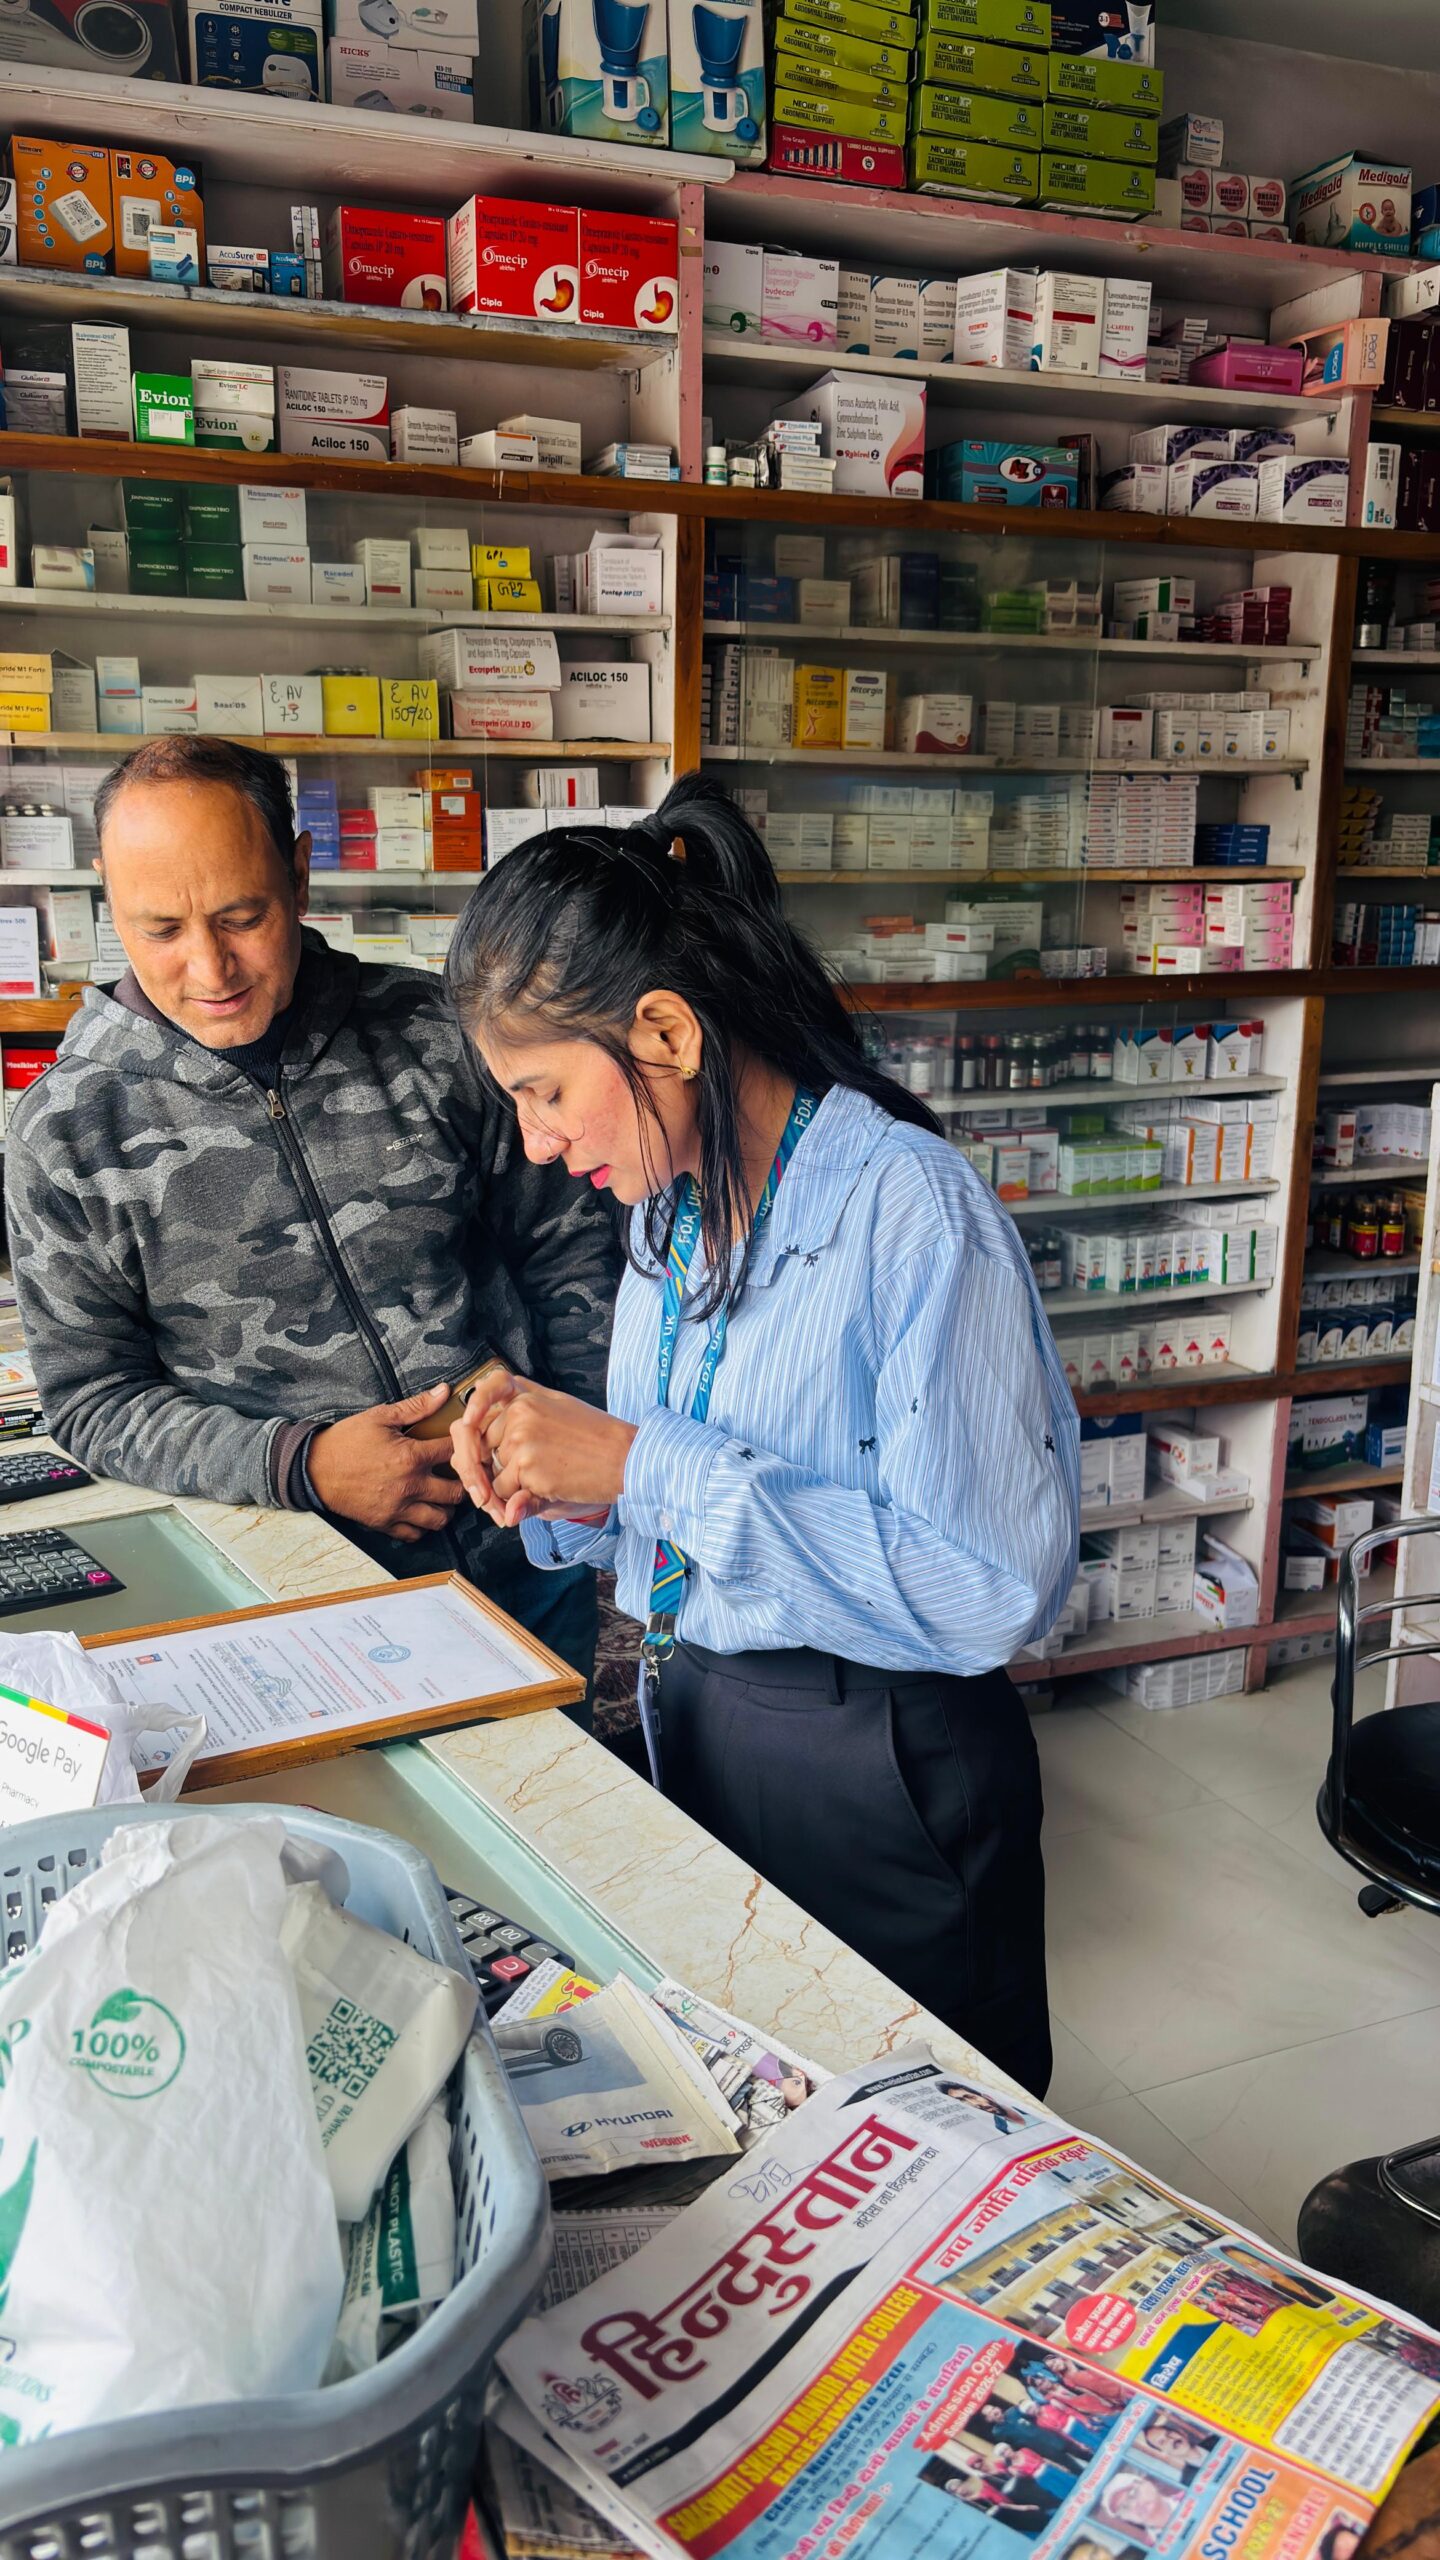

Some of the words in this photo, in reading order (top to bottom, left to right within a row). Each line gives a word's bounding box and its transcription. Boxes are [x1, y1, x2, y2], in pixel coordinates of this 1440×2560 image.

[219, 3, 253, 15] COMPACT
[254, 7, 293, 20] NEBULIZER
[823, 12, 847, 25] SUPPORT
[949, 13, 978, 25] UNIVERSAL
[956, 6, 977, 17] LUMBAR
[339, 46, 370, 57] HICKS
[784, 35, 814, 52] ABDOMINAL
[812, 45, 837, 58] SUPPORT
[933, 60, 946, 69] BELT
[946, 62, 974, 75] UNIVERSAL
[935, 53, 952, 62] SACRO
[952, 56, 974, 66] LUMBAR
[781, 108, 812, 122] ABDOMINAL
[811, 113, 835, 126] SUPPORT
[940, 164, 967, 177] UNIVERSAL
[947, 157, 967, 169] LUMBAR
[175, 174, 195, 185] BPL
[1358, 168, 1410, 186] Medigold
[1184, 182, 1207, 191] BREAST
[1220, 188, 1243, 196] BREAST
[1300, 174, 1343, 208] Medigold
[1256, 192, 1280, 201] BREAST
[1354, 240, 1382, 250] NIPPLE
[219, 250, 256, 261] AccuSure
[480, 246, 528, 268] Omecip
[85, 259, 106, 270] BPL
[346, 256, 395, 278] Omecip
[584, 258, 630, 280] Omecip
[819, 263, 835, 272] Cipla
[765, 287, 796, 297] budecort
[480, 297, 503, 308] Cipla
[583, 308, 605, 319] Cipla
[218, 381, 238, 390] Evion
[138, 388, 191, 407] Evion
[285, 388, 317, 403] RANITIDINE
[317, 392, 343, 405] TABLETS
[343, 395, 349, 406] IP
[359, 398, 368, 410] mg
[878, 399, 889, 409] Folic
[889, 401, 900, 412] Acid,
[286, 402, 312, 412] ACILOC
[313, 405, 326, 413] 150
[194, 417, 238, 432] Evion
[312, 436, 346, 450] Aciloc
[349, 439, 369, 451] 150
[284, 491, 300, 500] ASP
[468, 665, 501, 676] Ecosprin
[501, 666, 524, 675] GOLD
[569, 671, 607, 682] ACILOC
[610, 672, 628, 682] 150
[287, 684, 303, 701] AV
[411, 684, 430, 702] AV
[471, 719, 499, 728] Ecosprin
[499, 719, 520, 728] GOLD
[521, 720, 531, 729] 20
[793, 1096, 815, 1128] FDA,
[677, 1205, 700, 1245] FDA,
[664, 1314, 676, 1337] UK
[660, 1339, 672, 1378] FDA,
[699, 1355, 716, 1393] FDA,
[710, 1330, 723, 1352] UK
[0, 1720, 50, 1765] Google
[53, 1747, 83, 1782] Pay
[2, 1782, 40, 1809] Pharmacy
[500, 1927, 522, 1941] 00
[71, 2028, 160, 2063] 100%
[68, 2056, 156, 2077] COMPOSTABLE
[595, 2109, 674, 2127] HYUNDAI
[640, 2133, 694, 2149] OVERDRIVE
[885, 2156, 931, 2194] हिन्दुस्तान
[920, 2145, 942, 2161] का
[934, 2233, 974, 2270] नव
[963, 2183, 1019, 2234] ज्योति
[1009, 2154, 1060, 2188] पब्लिक
[1054, 2142, 1092, 2161] स्कूल
[388, 2216, 405, 2283] PLASTIC
[580, 2113, 923, 2401] हिन्दुस्तान
[920, 2374, 978, 2443] Admission
[970, 2339, 1003, 2377] Open
[944, 2398, 978, 2438] Session
[972, 2360, 1006, 2401] 2026-27
[665, 2469, 754, 2542] SARASWATI
[736, 2419, 802, 2487] SHISHU
[783, 2369, 847, 2437] MANDIR
[829, 2330, 880, 2385] INTER
[861, 2283, 923, 2345] COLLEGE
[763, 2481, 803, 2523] Class
[804, 2410, 866, 2478] Nursery
[859, 2393, 880, 2415] to
[876, 2359, 908, 2395] 12th
[768, 2376, 872, 2489] BAGESHWAR
[831, 2392, 914, 2486] 7351974709
[827, 2479, 863, 2516] हिन्दी
[914, 2396, 931, 2413] से
[1199, 2468, 1276, 2560] SCHOOL
